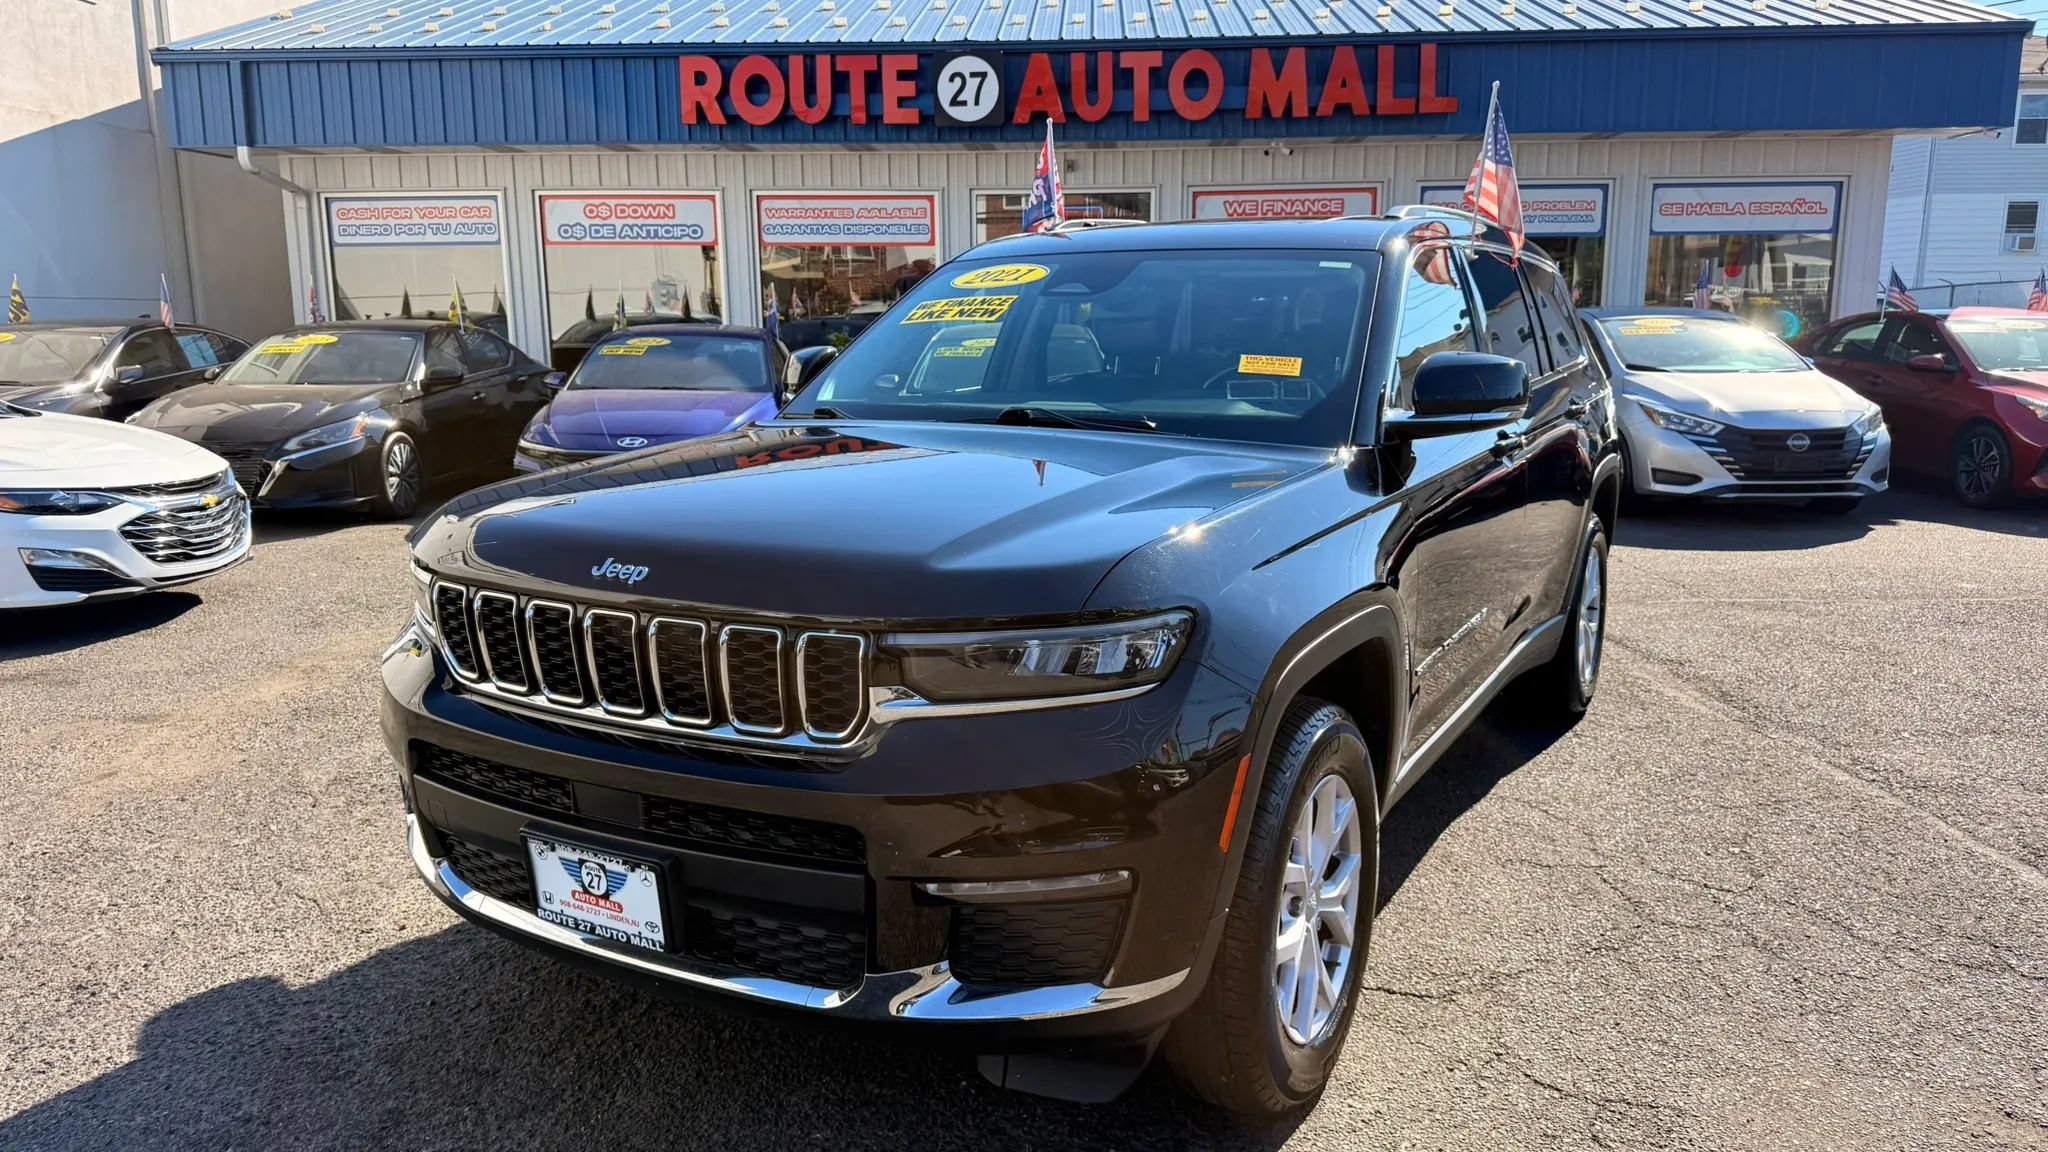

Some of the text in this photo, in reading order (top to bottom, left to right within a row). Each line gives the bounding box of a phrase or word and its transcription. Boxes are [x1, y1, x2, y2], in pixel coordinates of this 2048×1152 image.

[679, 43, 1458, 126] ROUTE 27 AUTO MALL
[336, 206, 492, 221] CASH FOR YOUR CAR
[614, 203, 676, 219] DOWN
[765, 207, 854, 219] WARRANTIES
[1223, 198, 1345, 217] WE FINANCE
[1532, 200, 1597, 212] PROBLEM
[1659, 198, 1828, 216] SE HABLA ESPAÑOL
[1537, 214, 1595, 224] PROBLEMA
[338, 222, 497, 237] DINERO POR TU AUTO
[589, 224, 616, 239] DE
[617, 223, 703, 240] ANTICIPO
[763, 223, 930, 236] GARANTIAS DISPONIBLES
[962, 268, 1037, 285] 2021
[915, 296, 1014, 311] WE FINANCE
[907, 307, 1006, 321] LIKE NEW
[591, 557, 649, 584] Jeep
[584, 864, 601, 874] ROUTE
[585, 871, 602, 892] 27
[574, 891, 622, 912] AUTO MALL
[537, 908, 665, 953] ROUTE 27 AUTO MALL
